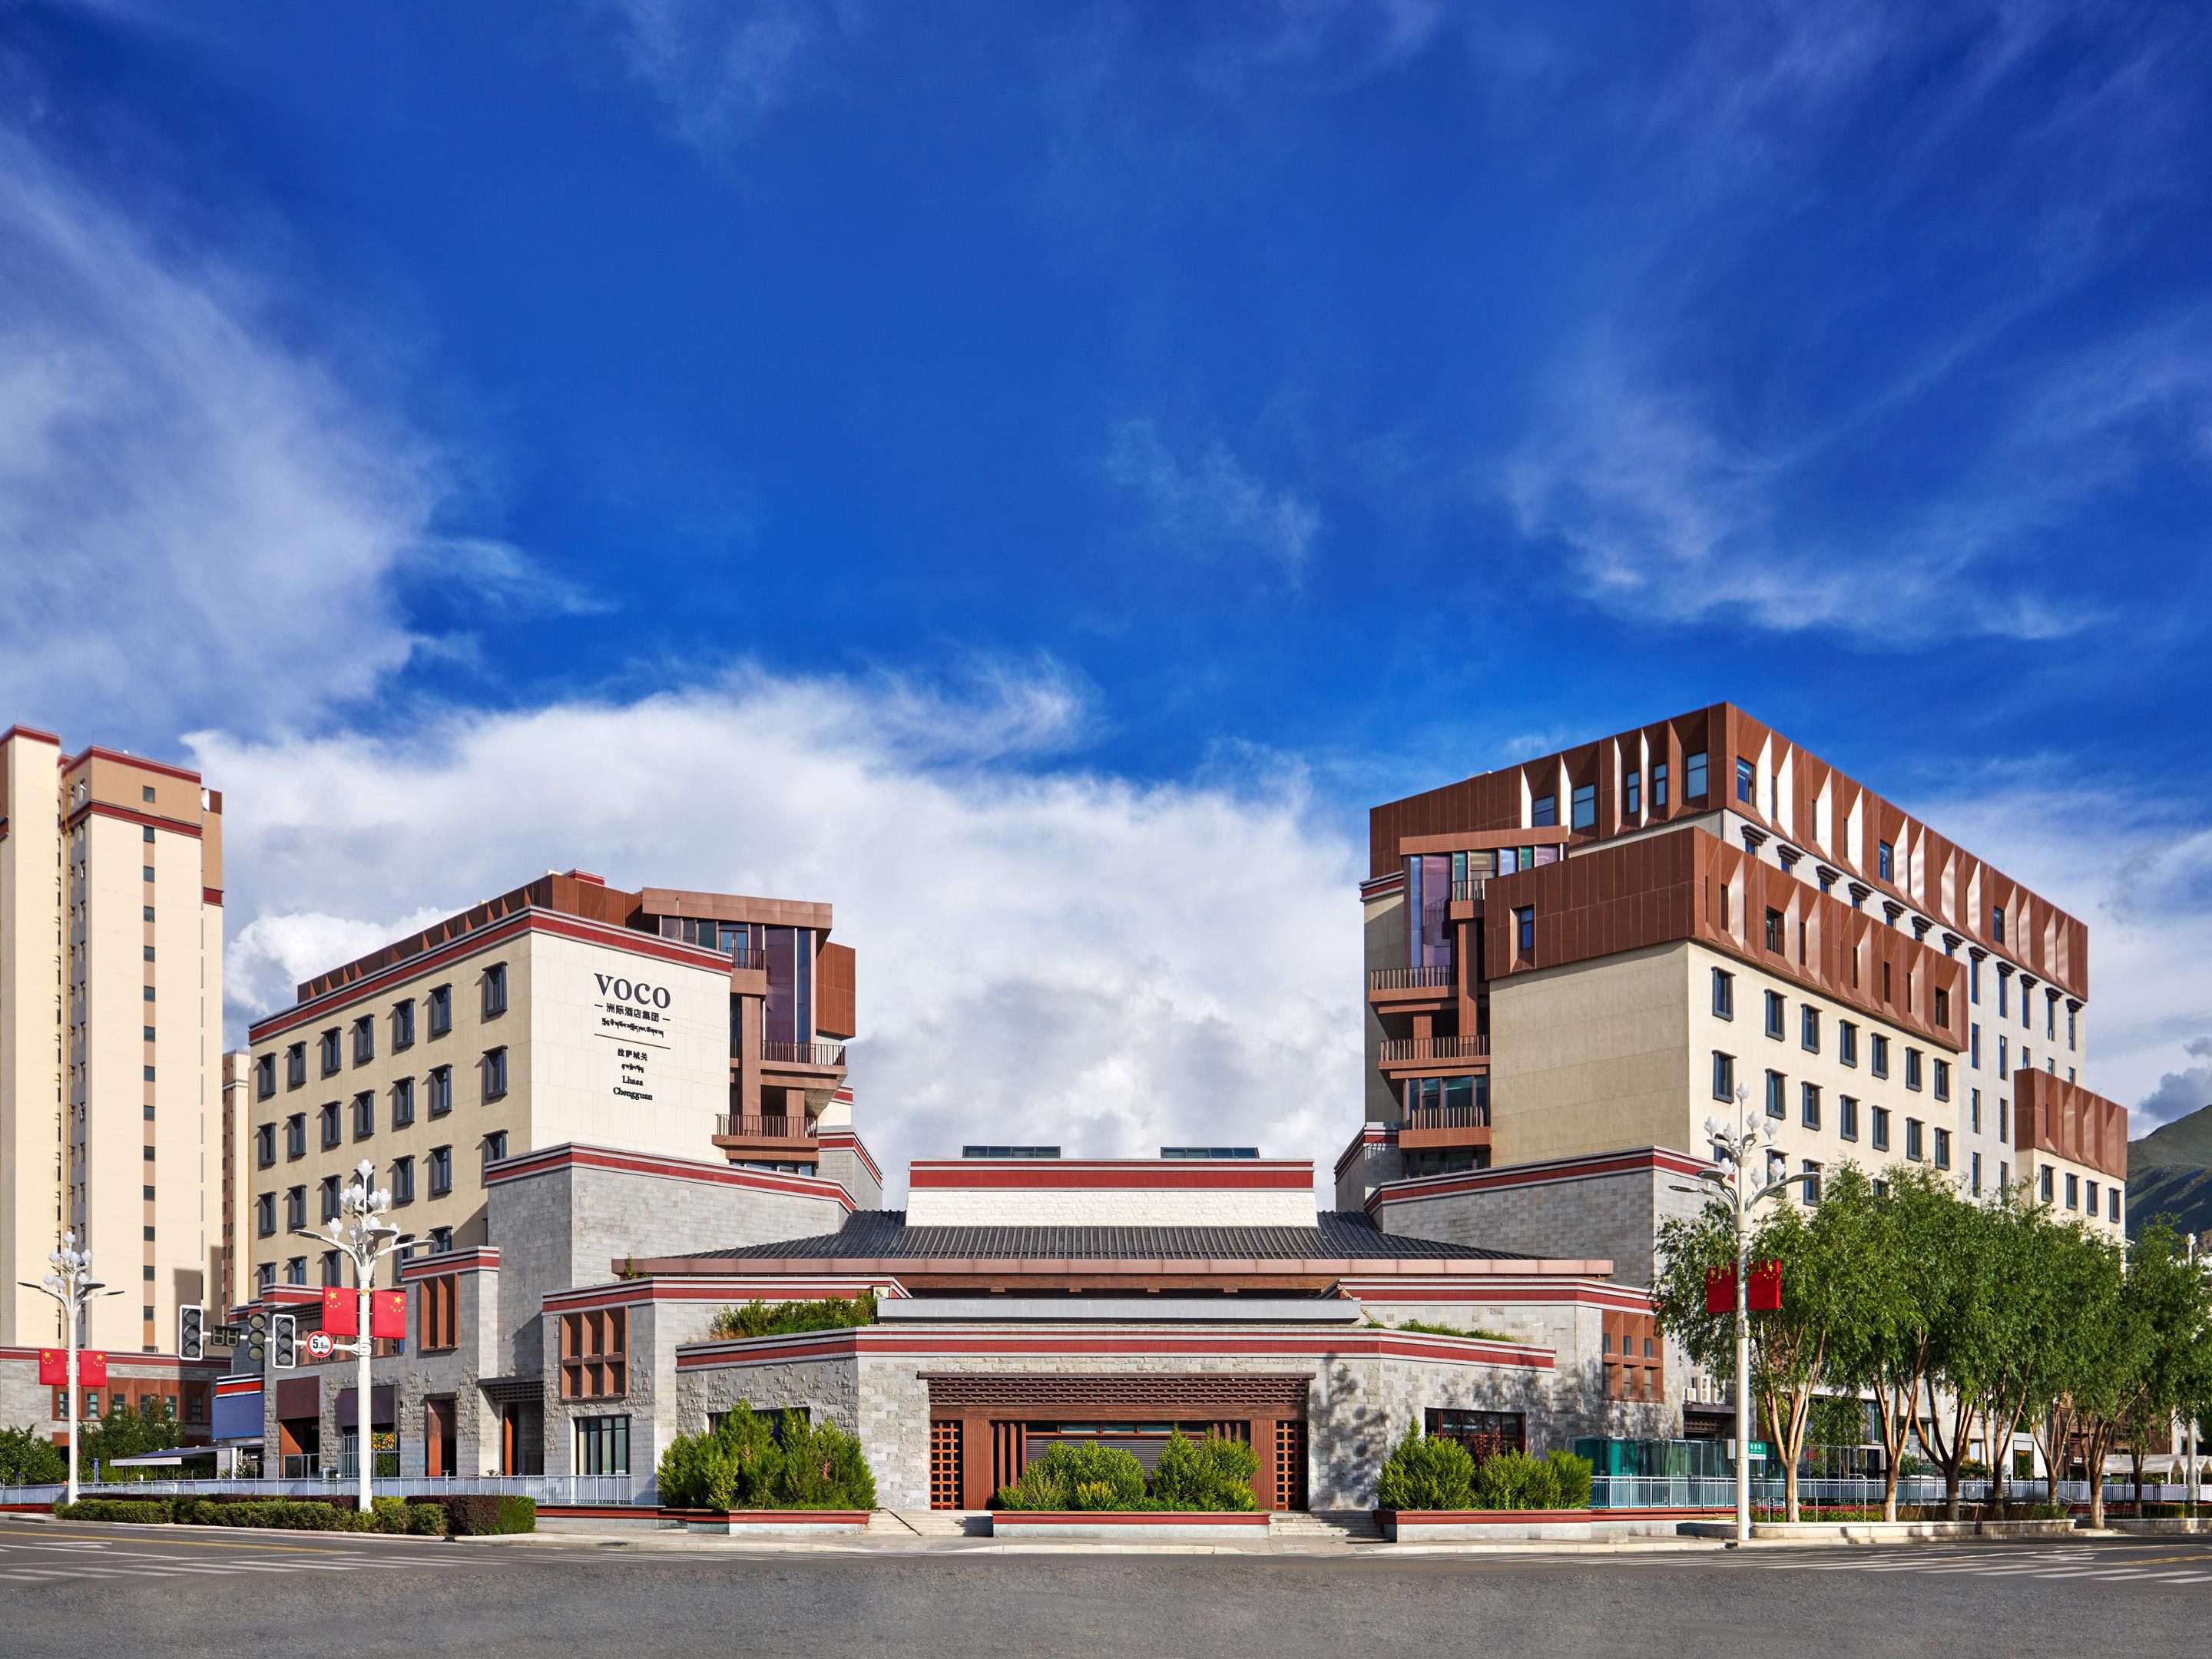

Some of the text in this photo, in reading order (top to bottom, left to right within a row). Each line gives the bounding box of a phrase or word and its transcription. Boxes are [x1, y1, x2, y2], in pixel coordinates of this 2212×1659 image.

[607, 1003, 659, 1022] 洲际酒店集团
[621, 1075, 644, 1087] Lhasa
[612, 1087, 653, 1101] Chengguan
